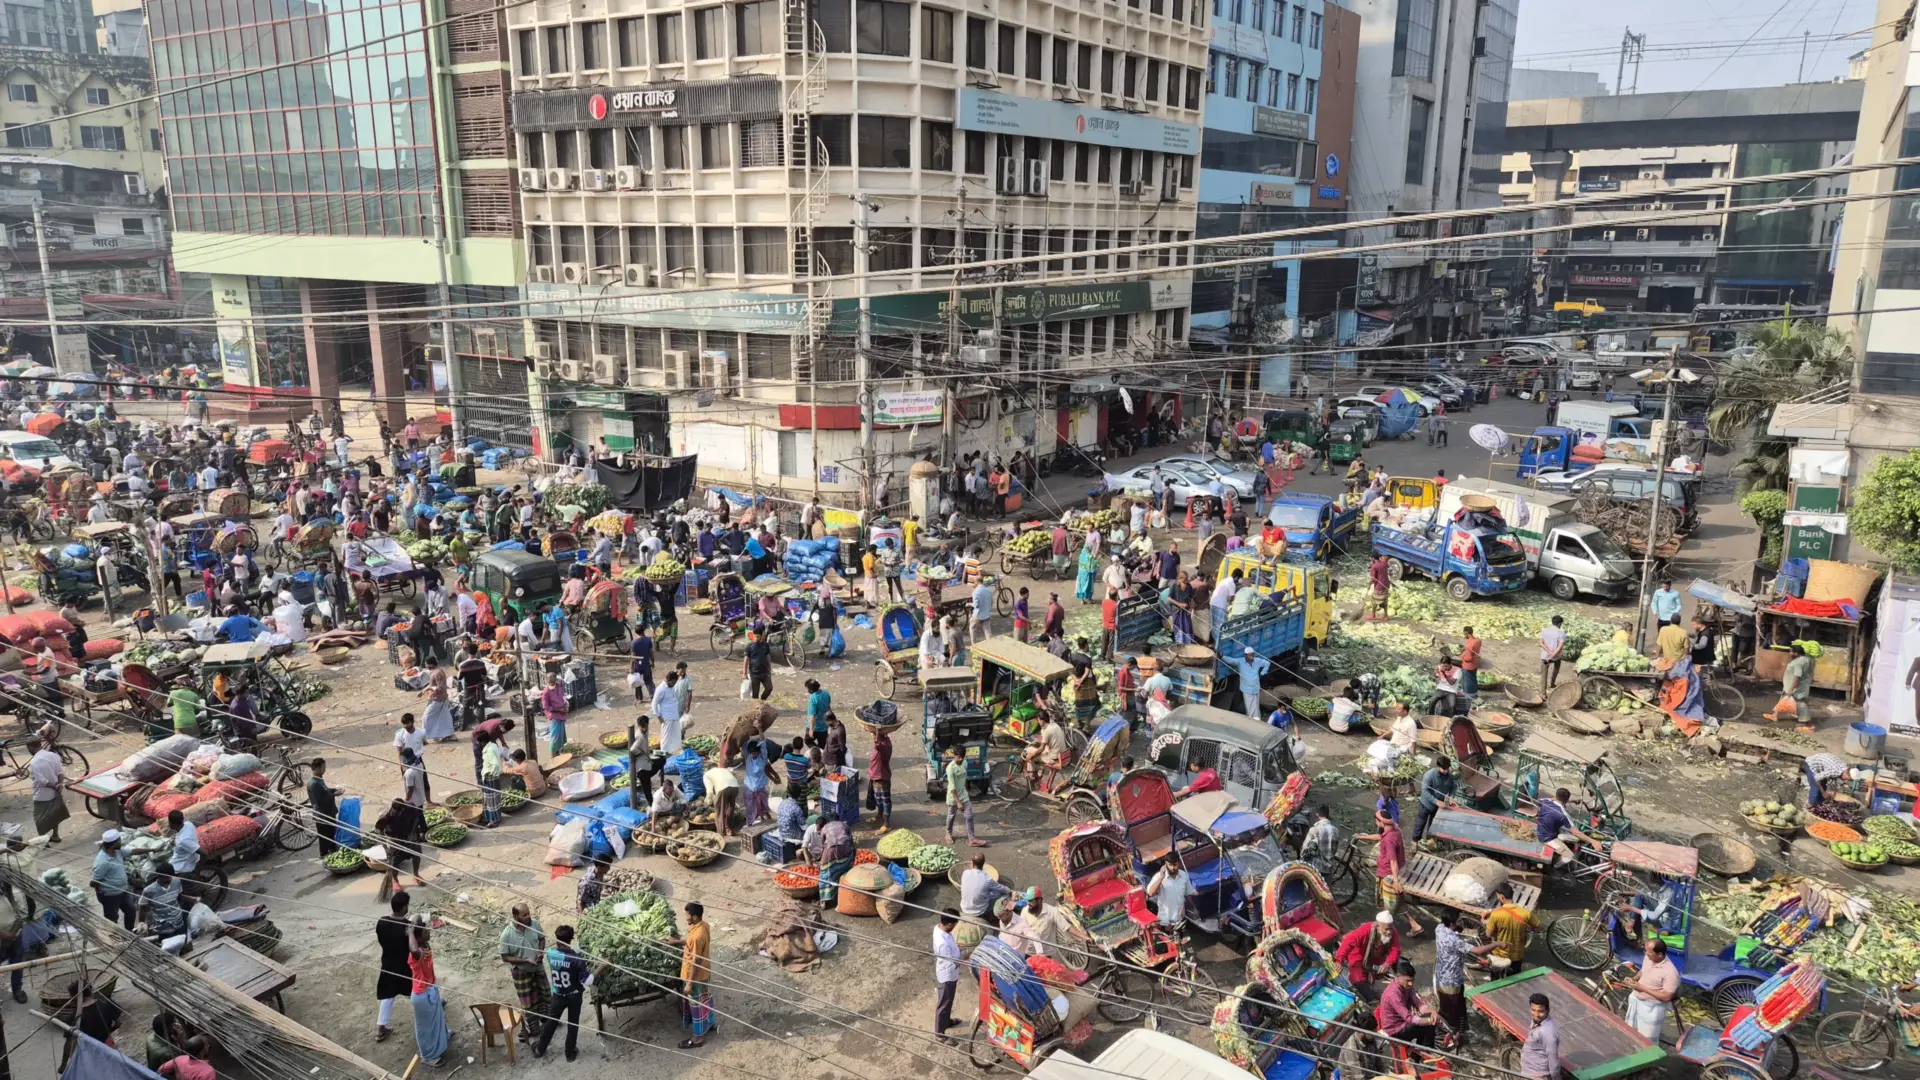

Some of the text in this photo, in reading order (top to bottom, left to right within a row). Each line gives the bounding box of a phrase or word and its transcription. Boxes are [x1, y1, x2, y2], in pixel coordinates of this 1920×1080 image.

[612, 89, 676, 111] ওয়ান ব্যাংক
[1049, 290, 1122, 307] PUBALI BANK PLC
[1798, 529, 1825, 538] Bank
[1799, 541, 1821, 549] PLC
[551, 970, 571, 988] 28
